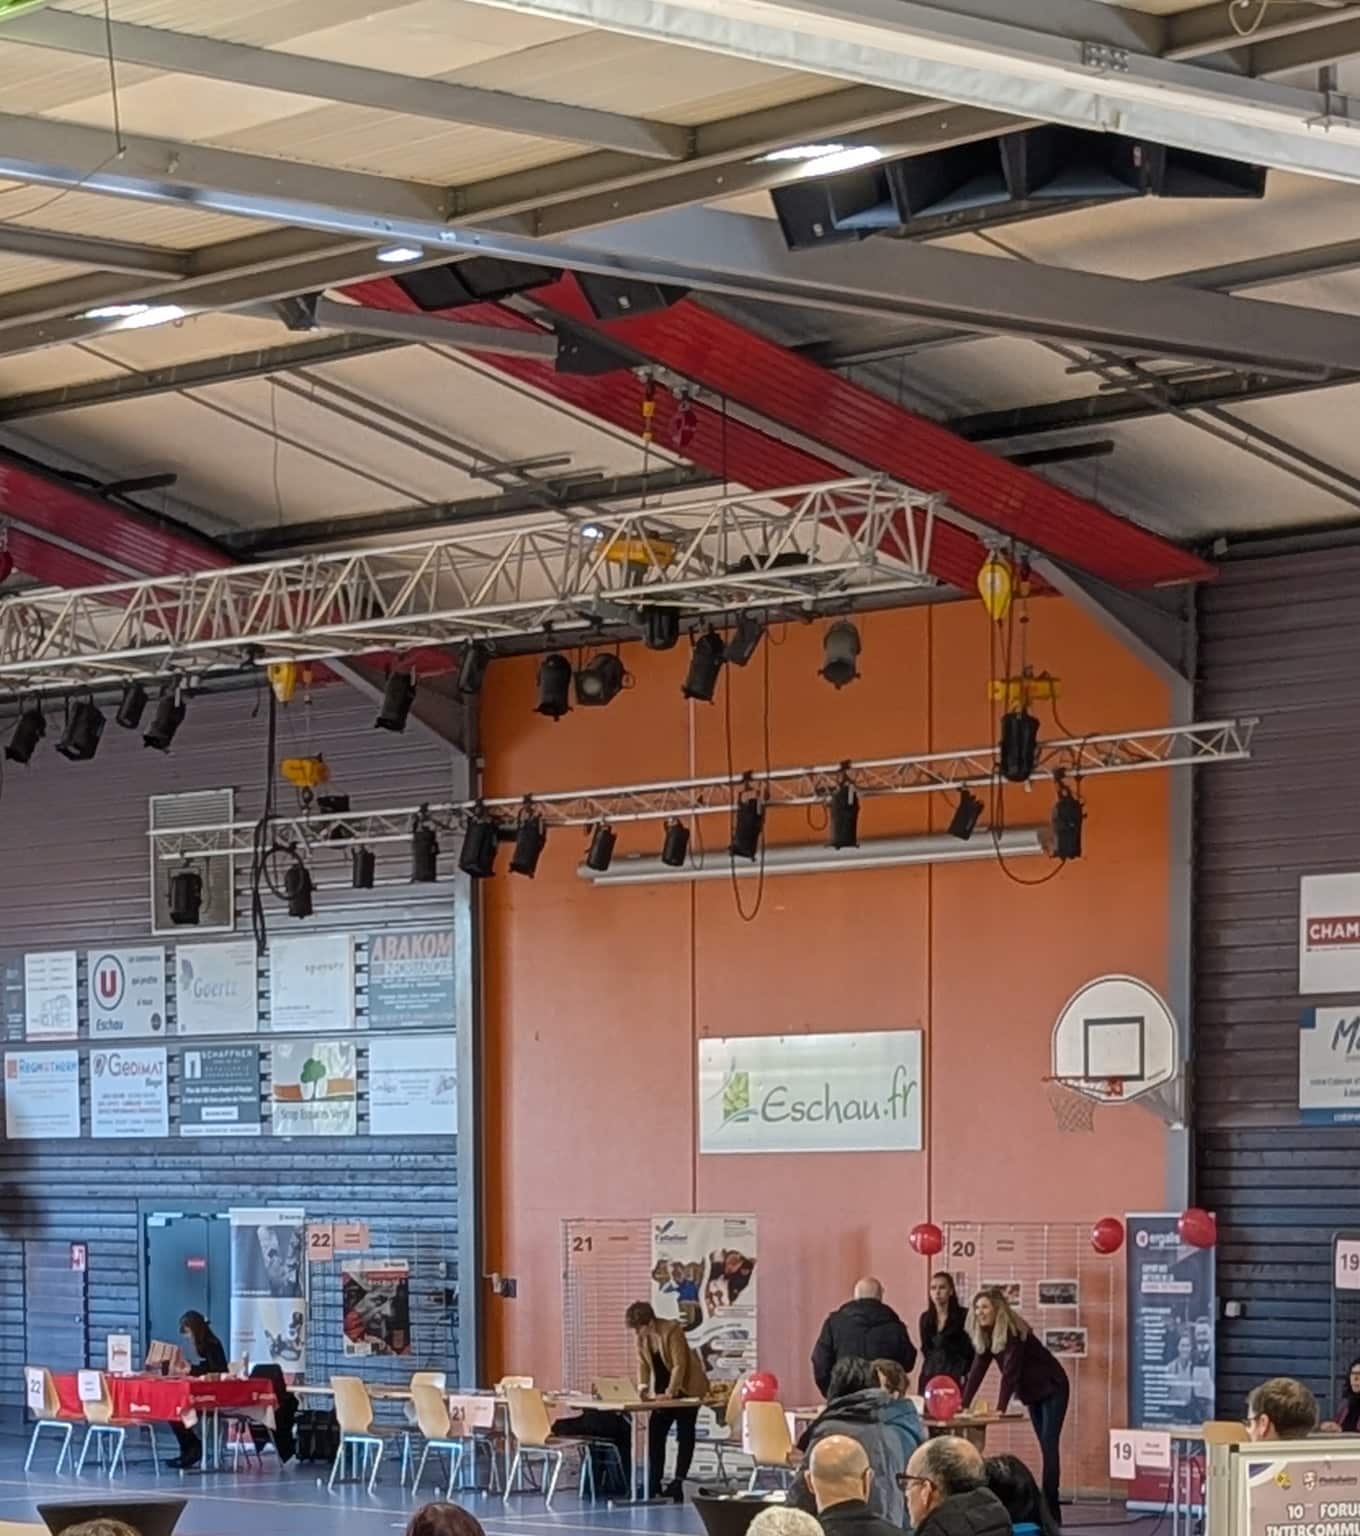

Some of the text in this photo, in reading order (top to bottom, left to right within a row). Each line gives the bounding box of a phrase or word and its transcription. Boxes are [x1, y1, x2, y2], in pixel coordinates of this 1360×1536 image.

[371, 933, 453, 961] ABAKOM
[100, 970, 117, 998] U
[760, 1065, 918, 1123] Eschau.fr
[311, 1233, 331, 1247] 22
[572, 1236, 593, 1252] 21
[952, 1240, 976, 1257] 20
[1340, 1253, 1360, 1271] 19
[30, 1380, 41, 1394] 22
[451, 1406, 466, 1421] 21
[1113, 1441, 1133, 1461] 19
